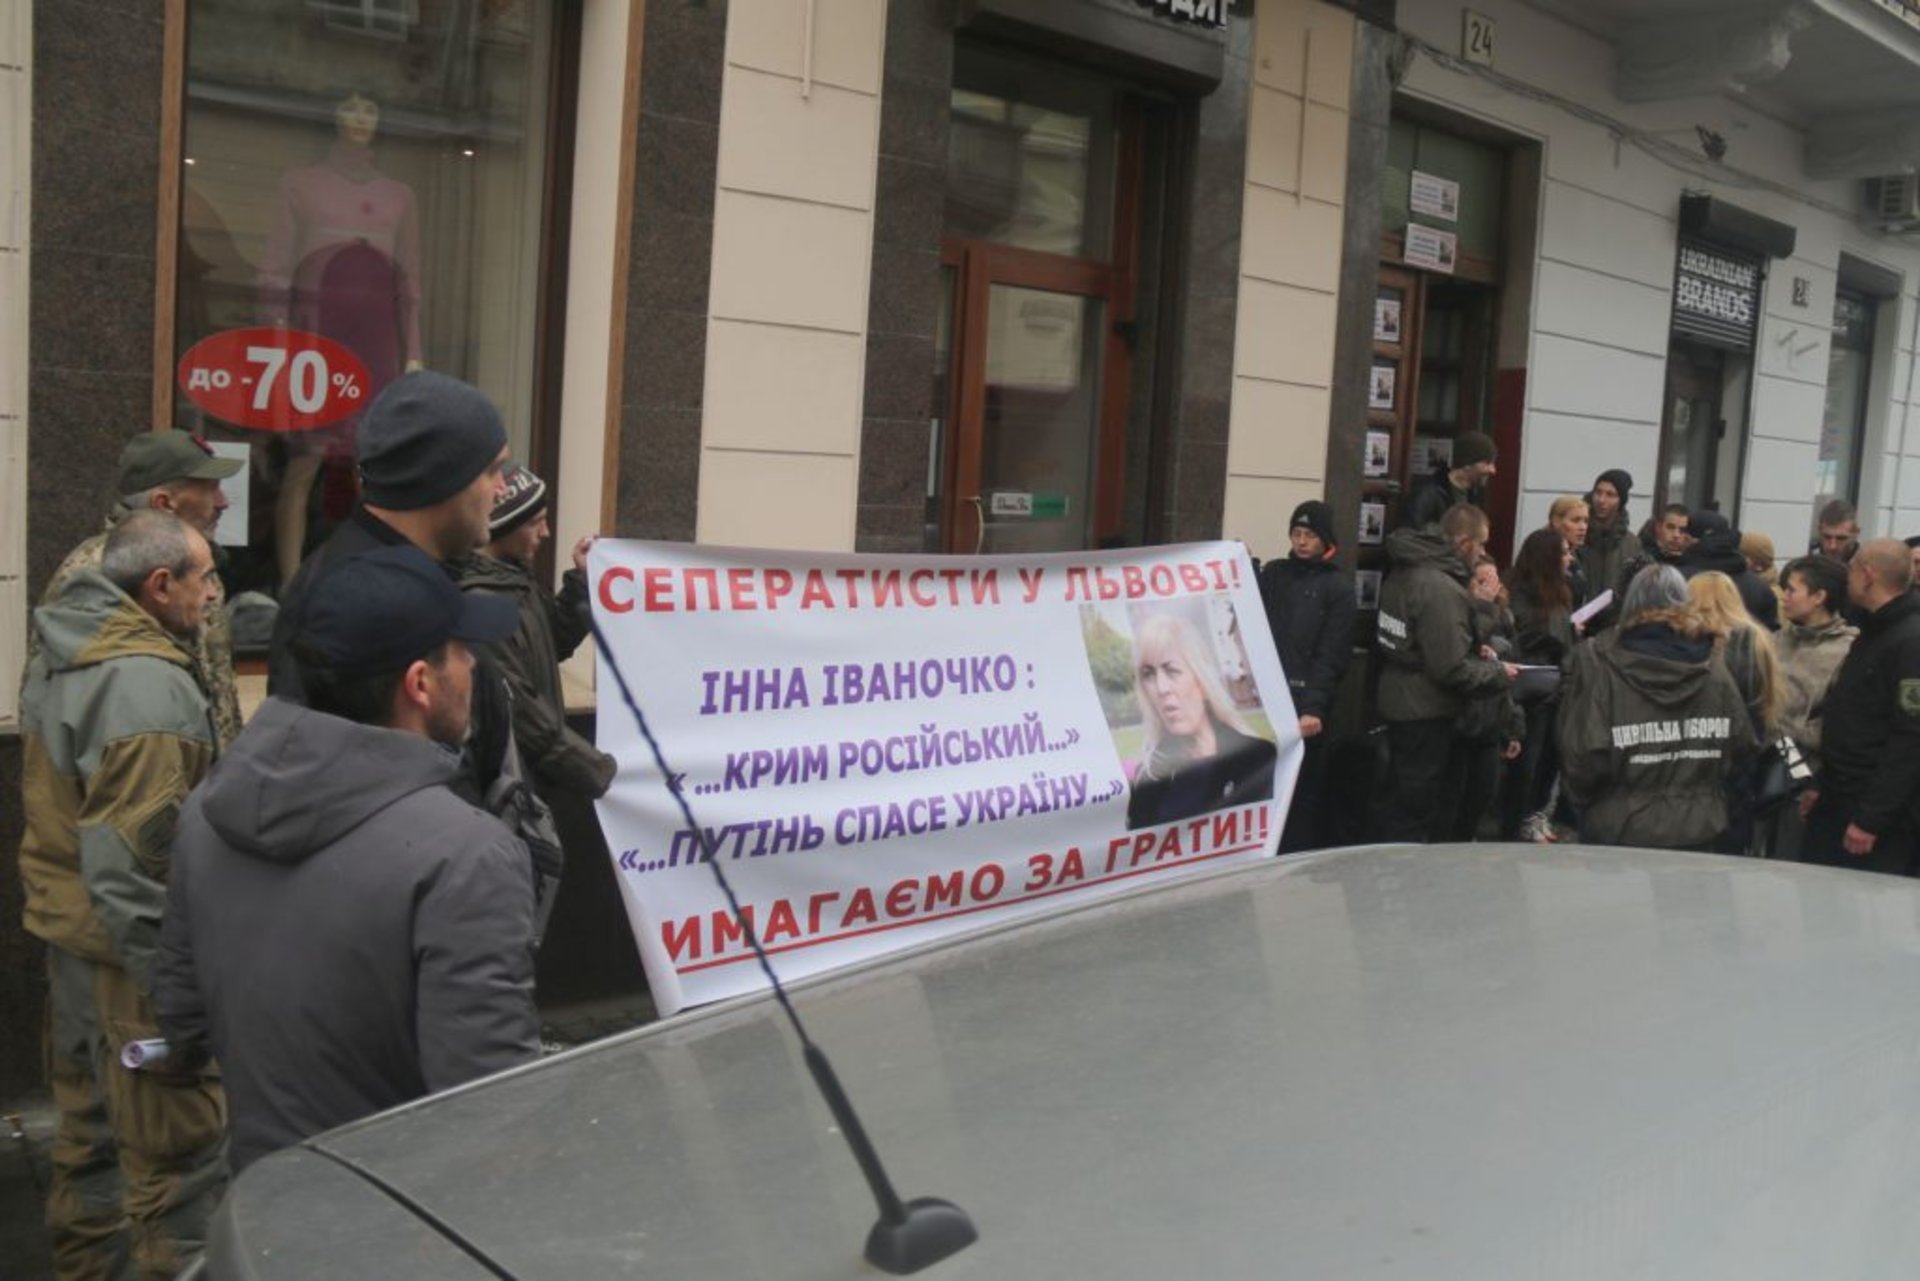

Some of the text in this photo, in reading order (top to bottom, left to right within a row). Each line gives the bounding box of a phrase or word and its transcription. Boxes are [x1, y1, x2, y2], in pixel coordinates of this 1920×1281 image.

[1155, 0, 1236, 25] ДЯГ
[1471, 21, 1492, 57] 24
[1676, 275, 1752, 324] BRANDS
[188, 368, 231, 391] до
[599, 558, 1241, 613] СЕПЕРАТИСТИ У ЛЬВОВІ!
[700, 667, 809, 715] ІННА
[835, 799, 946, 846] СПАСЕ
[1025, 847, 1084, 892] ЗА
[1105, 805, 1268, 873] ГРАТИ!!
